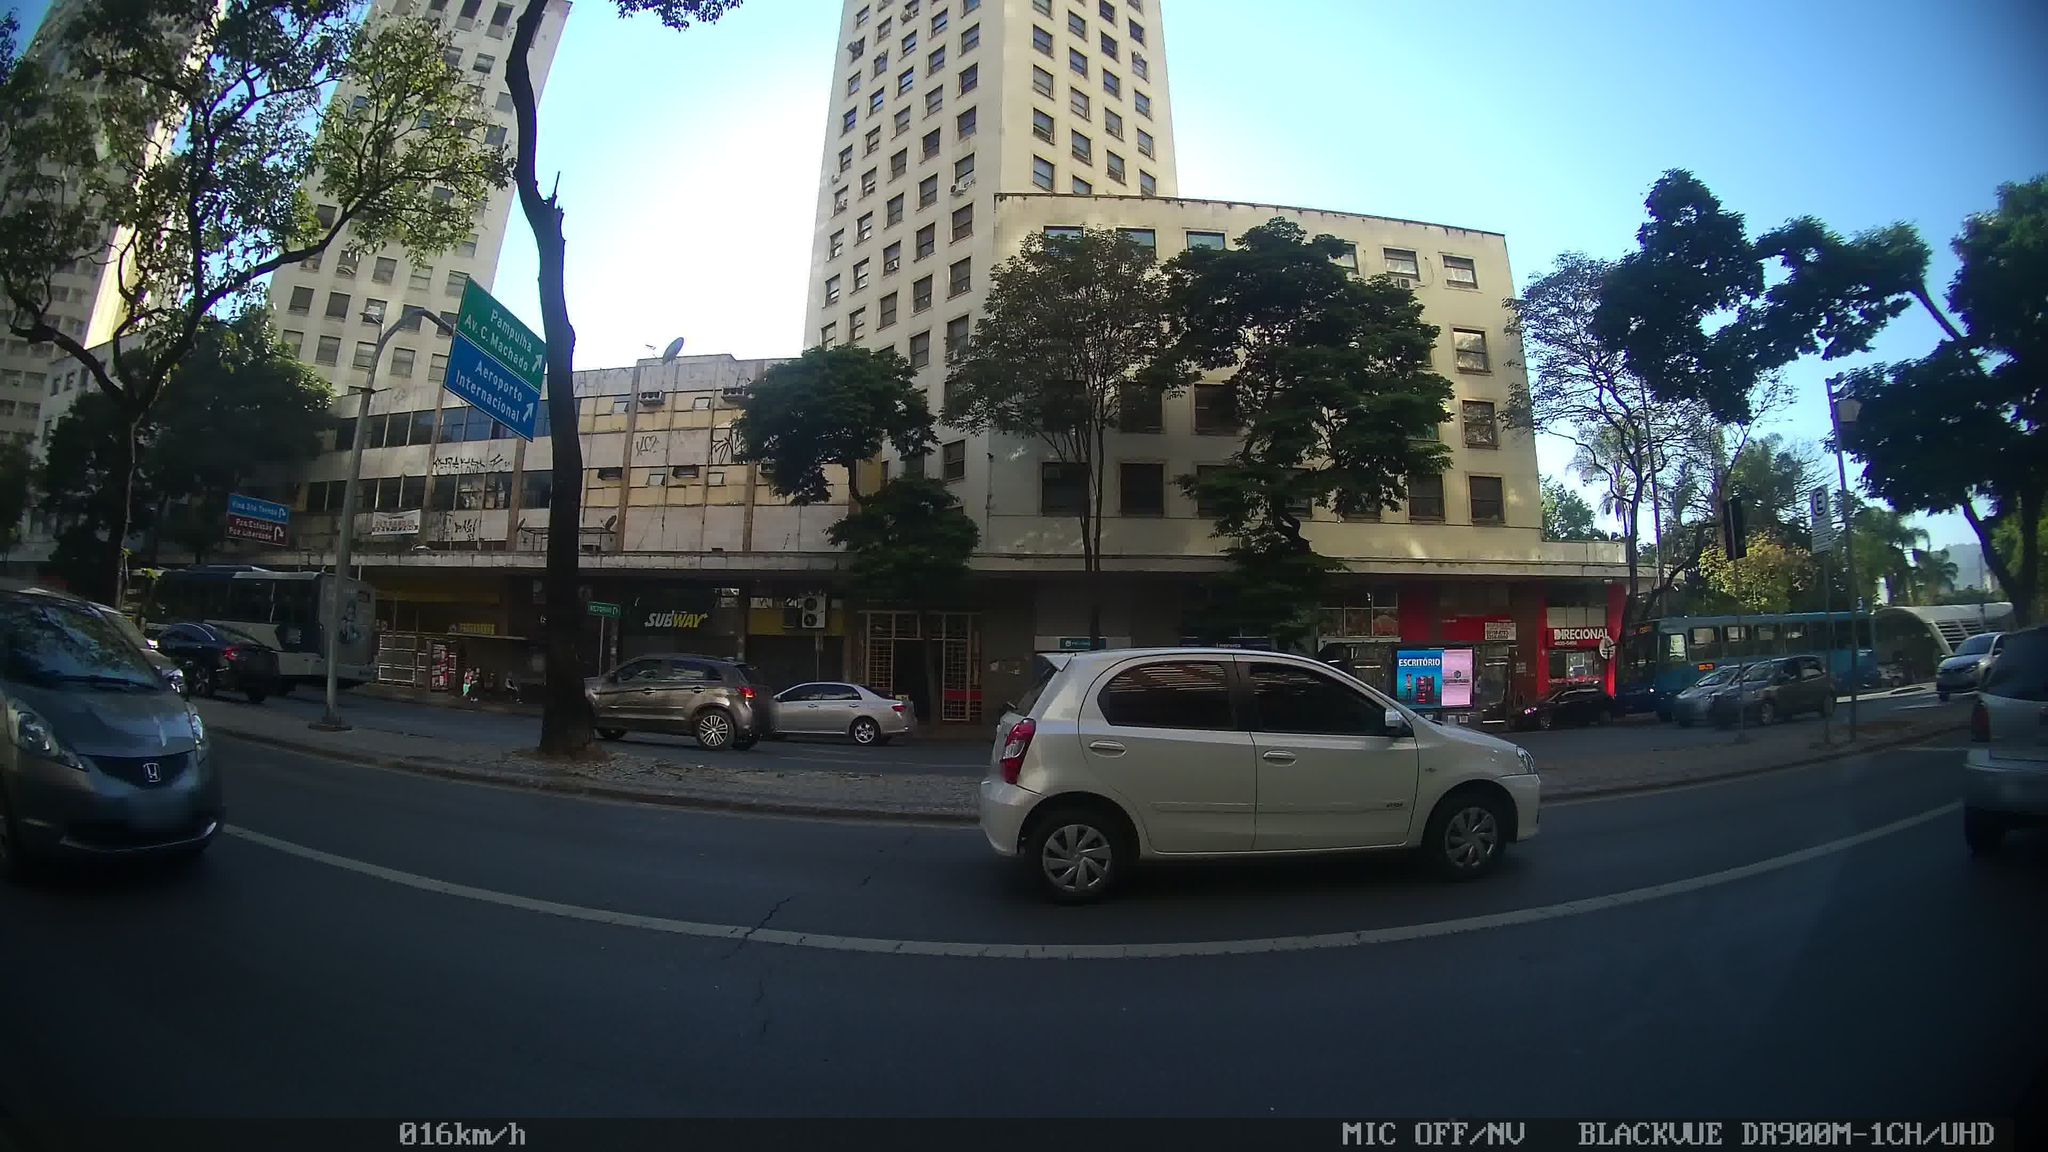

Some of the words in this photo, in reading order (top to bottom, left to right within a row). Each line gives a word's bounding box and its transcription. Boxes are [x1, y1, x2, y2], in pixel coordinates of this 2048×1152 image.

[464, 314, 478, 334] Av.
[480, 327, 489, 342] C.
[490, 334, 528, 372] Machado
[490, 309, 532, 352] Pampulha
[456, 370, 520, 423] Internacional
[475, 360, 523, 402] Aeroporto
[644, 612, 708, 628] SUBWAY
[1553, 628, 1608, 640] DIRECIONAL
[1398, 657, 1440, 667] ESCRITÓRIO
